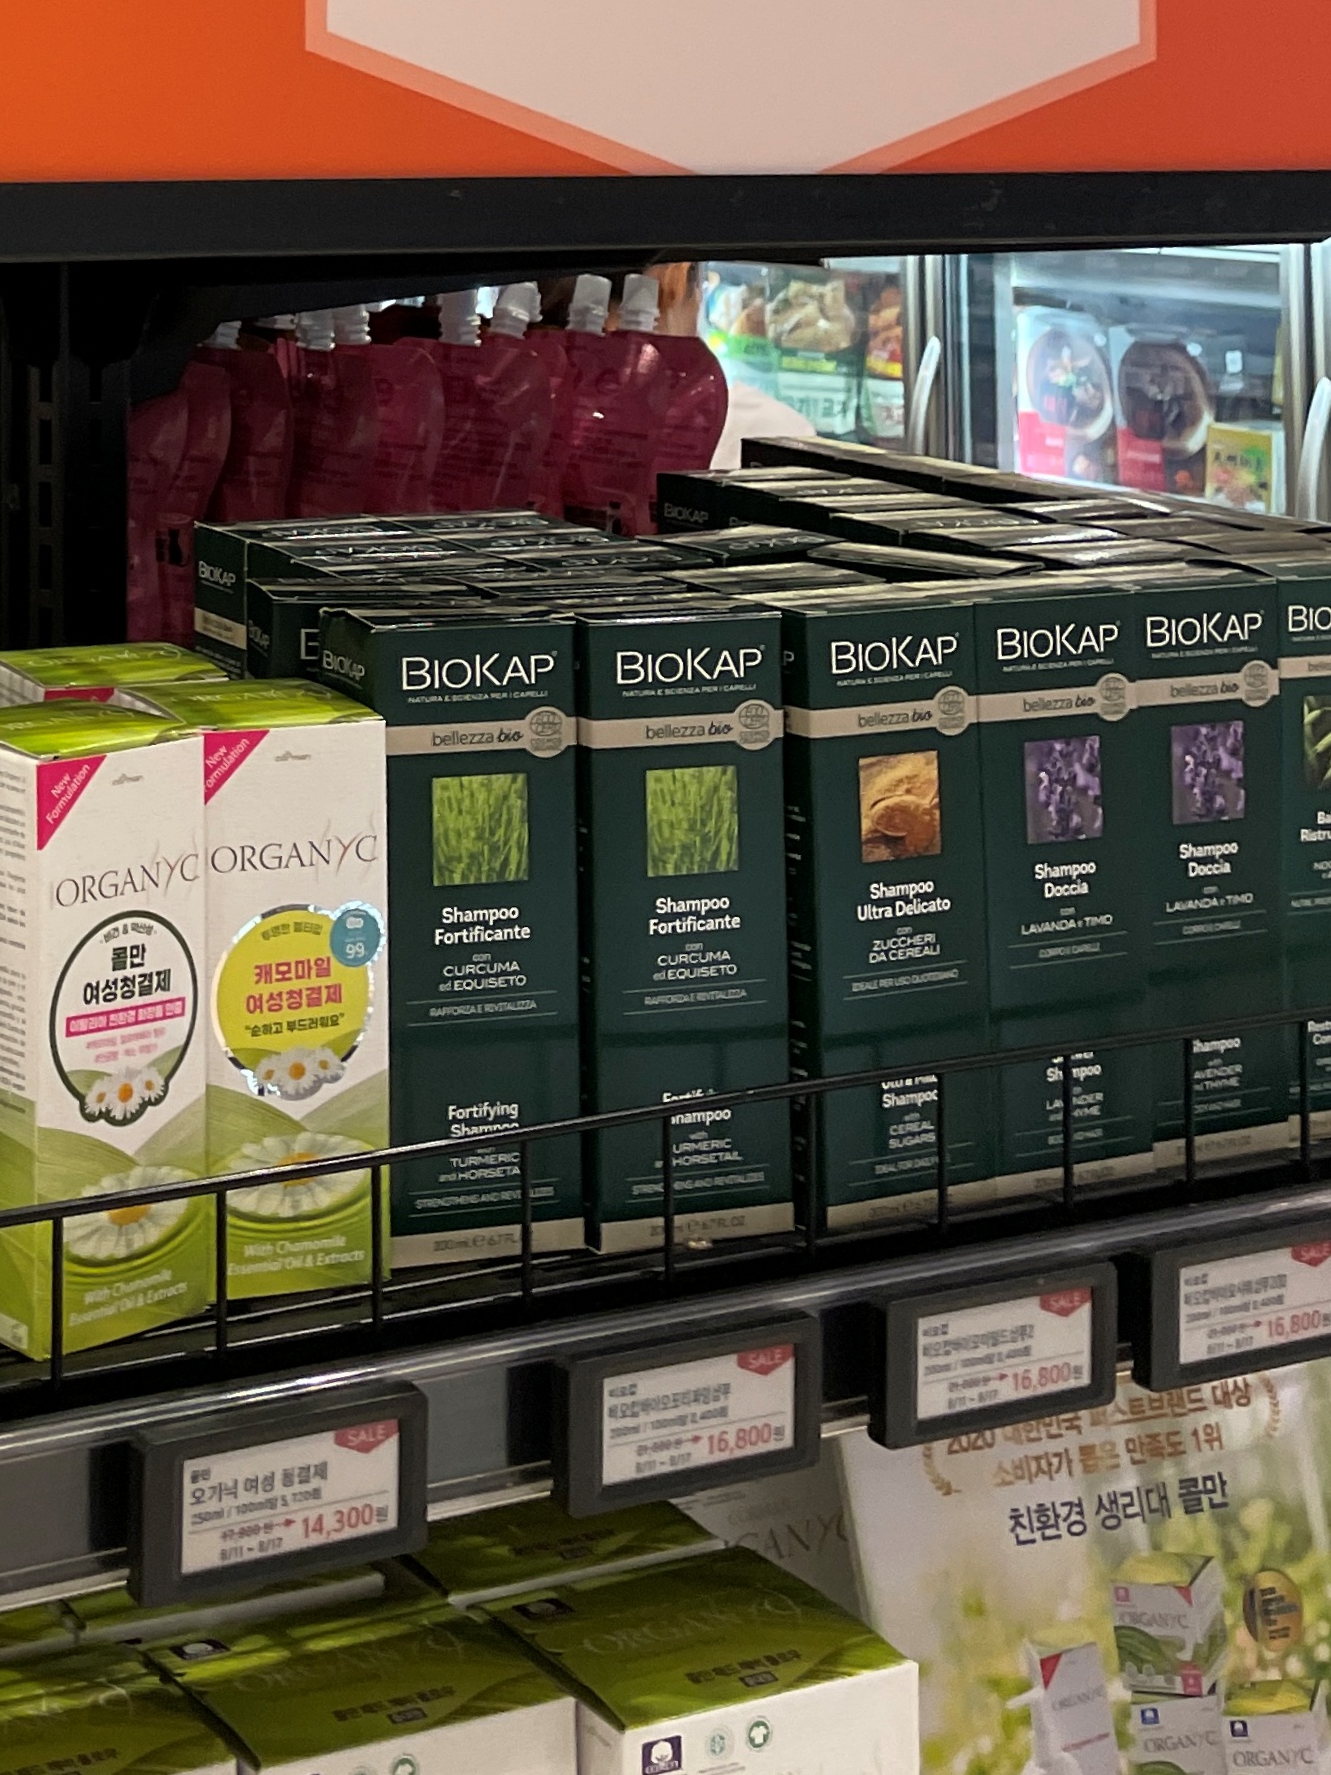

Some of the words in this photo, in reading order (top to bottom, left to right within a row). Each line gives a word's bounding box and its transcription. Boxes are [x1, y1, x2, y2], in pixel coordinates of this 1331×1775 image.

[1146, 612, 1263, 647] BIOKAP
[997, 623, 1119, 660] BIOKAP
[831, 635, 957, 674] BIOKAP
[323, 651, 365, 682] BIOKAP
[402, 652, 557, 691] BIOKAP
[617, 646, 764, 685] BIOKAP
[1171, 683, 1218, 698] bellezza
[1220, 681, 1240, 694] bio
[1023, 697, 1073, 712] bellezza
[1075, 694, 1096, 709] bio
[858, 712, 910, 728] bellezza
[912, 709, 933, 723] bio
[432, 730, 494, 747] bellezza
[497, 727, 524, 743] bio
[646, 724, 705, 740] bellezza
[708, 721, 733, 736] bio
[205, 743, 229, 770] New
[45, 763, 91, 825] Formulation
[51, 771, 71, 799] New
[210, 834, 378, 875] ORGANYC
[1179, 841, 1239, 860] Shampoo
[1034, 861, 1097, 880] Shampoo
[1188, 858, 1232, 877] Doccia
[56, 853, 201, 907] ORGANYC
[1044, 879, 1089, 898] Doccia
[870, 881, 935, 900] Shampoo
[655, 896, 730, 915] Shampoo
[857, 904, 894, 922] Ultra
[895, 897, 952, 917] Delicato
[1165, 897, 1219, 913] LAVANDA
[441, 906, 520, 926] Shampoo
[648, 913, 741, 936] Fortificante
[1021, 919, 1077, 936] LAVANDA
[1083, 914, 1114, 927] TIMO
[434, 924, 532, 945] Fortificante
[872, 933, 937, 951] ZUCCHERI
[112, 943, 147, 972] 콜만
[657, 950, 731, 966] CURCUMA
[869, 952, 888, 963] DA
[888, 944, 941, 961] CEREALI
[253, 956, 332, 986] 캐모마일
[443, 961, 520, 977] CURCUMA
[667, 964, 738, 980] EQUISETO
[83, 968, 172, 1006] 여성청결제
[453, 975, 527, 991] EQUISETO
[245, 983, 343, 1015] 여성청결제
[448, 1101, 519, 1121] Fortifying
[671, 1109, 732, 1126] hampoo
[672, 1138, 732, 1154] URMERIC
[450, 1152, 521, 1168] TURMERIC
[276, 1234, 347, 1255] Chamomile
[317, 1247, 366, 1266] Extracts
[749, 1349, 784, 1369] SALE
[1211, 1377, 1253, 1411] 대상
[348, 1426, 387, 1446] SALE
[994, 1447, 1074, 1489] 소비자가
[1125, 1429, 1188, 1467] 만족도
[1191, 1420, 1225, 1454] 1위
[189, 1478, 238, 1506] 오가닉
[244, 1470, 275, 1495] 여성
[1008, 1496, 1089, 1547] 친환경
[1095, 1480, 1173, 1531] 생리대
[1178, 1470, 1231, 1516] 콜만
